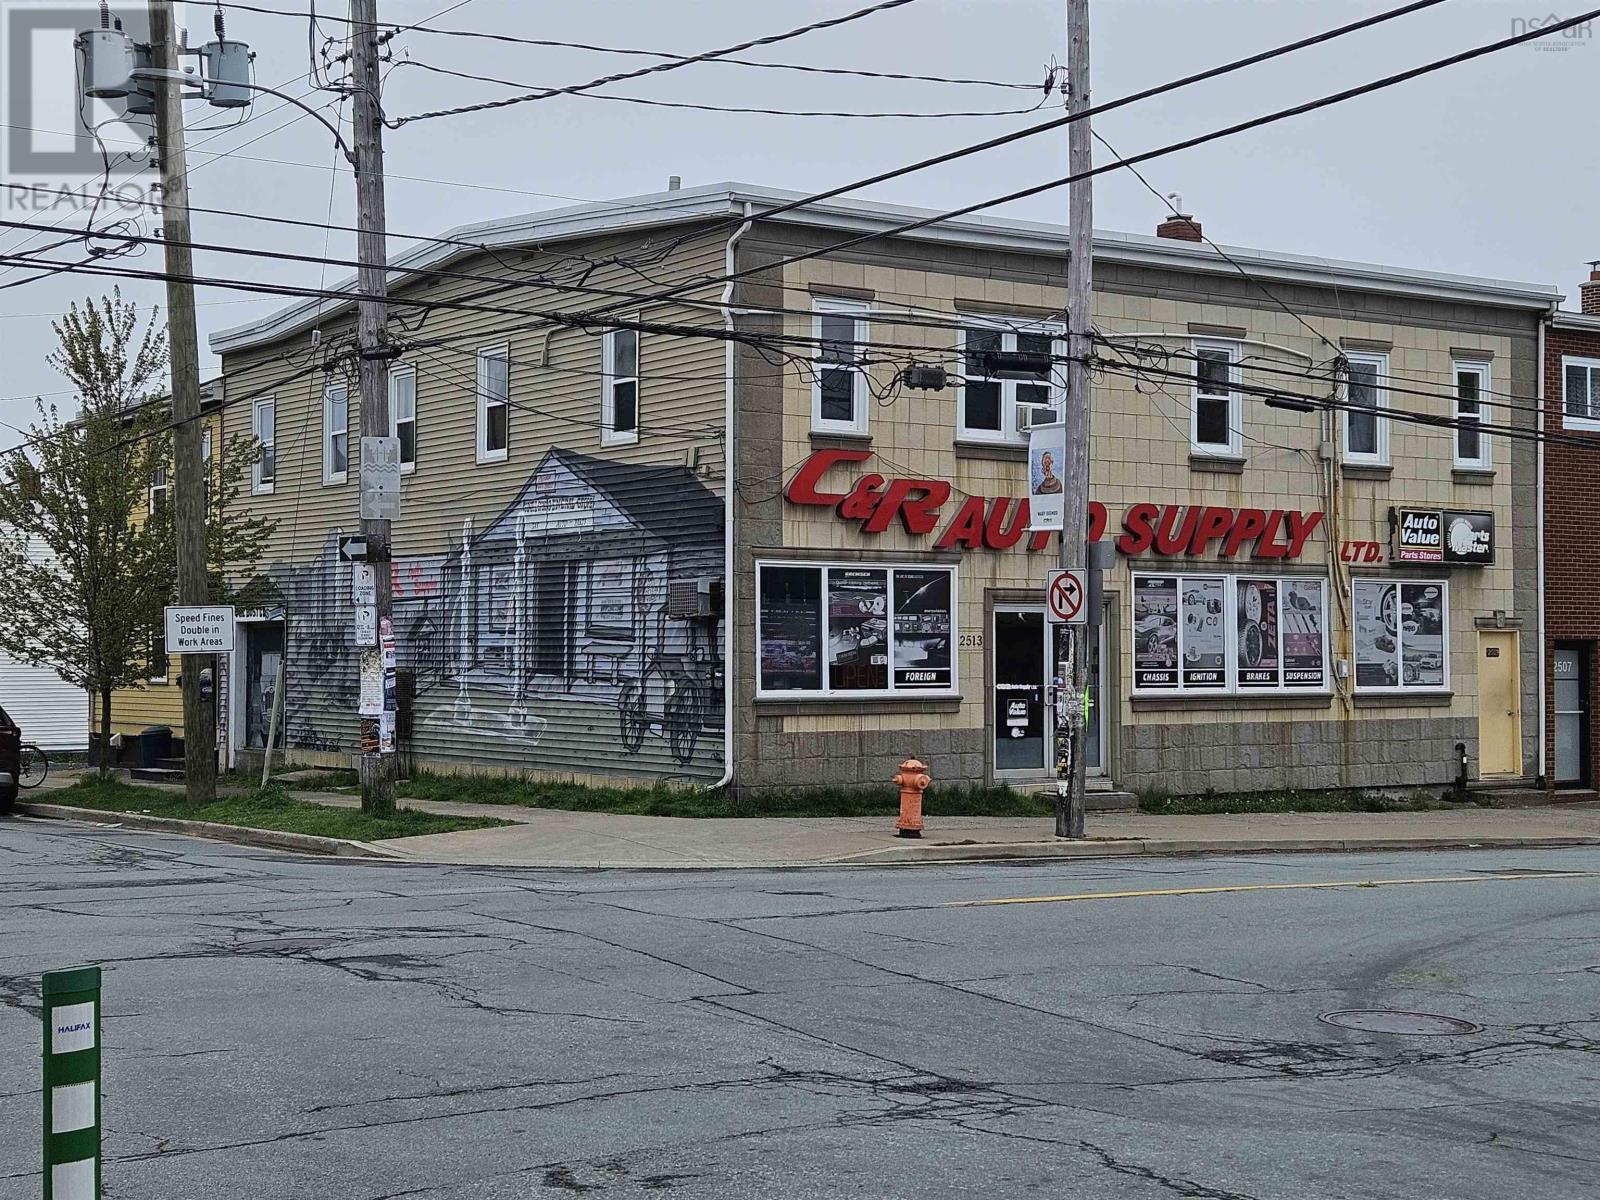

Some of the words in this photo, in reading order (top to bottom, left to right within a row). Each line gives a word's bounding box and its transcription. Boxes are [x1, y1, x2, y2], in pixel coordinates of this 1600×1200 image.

[783, 449, 951, 534] C&R
[1118, 504, 1323, 560] SUPPLY
[1403, 514, 1438, 530] Auto
[1402, 529, 1440, 545] Value
[1400, 551, 1418, 560] Parts
[1420, 552, 1442, 561] Stores
[175, 612, 201, 624] Speed
[202, 613, 225, 622] Fines
[180, 625, 210, 634] Double
[178, 638, 198, 646] Work
[200, 637, 223, 645] Areas
[959, 635, 983, 646] 2513
[1553, 661, 1572, 672] 2507
[905, 672, 936, 681] FOREIGN
[1143, 673, 1169, 681] CHASSIS
[1190, 673, 1217, 681] IGNITION
[1246, 672, 1270, 680] BRAKES
[1286, 672, 1321, 680] SUSPENSION
[59, 1023, 90, 1033] HALIFAX
